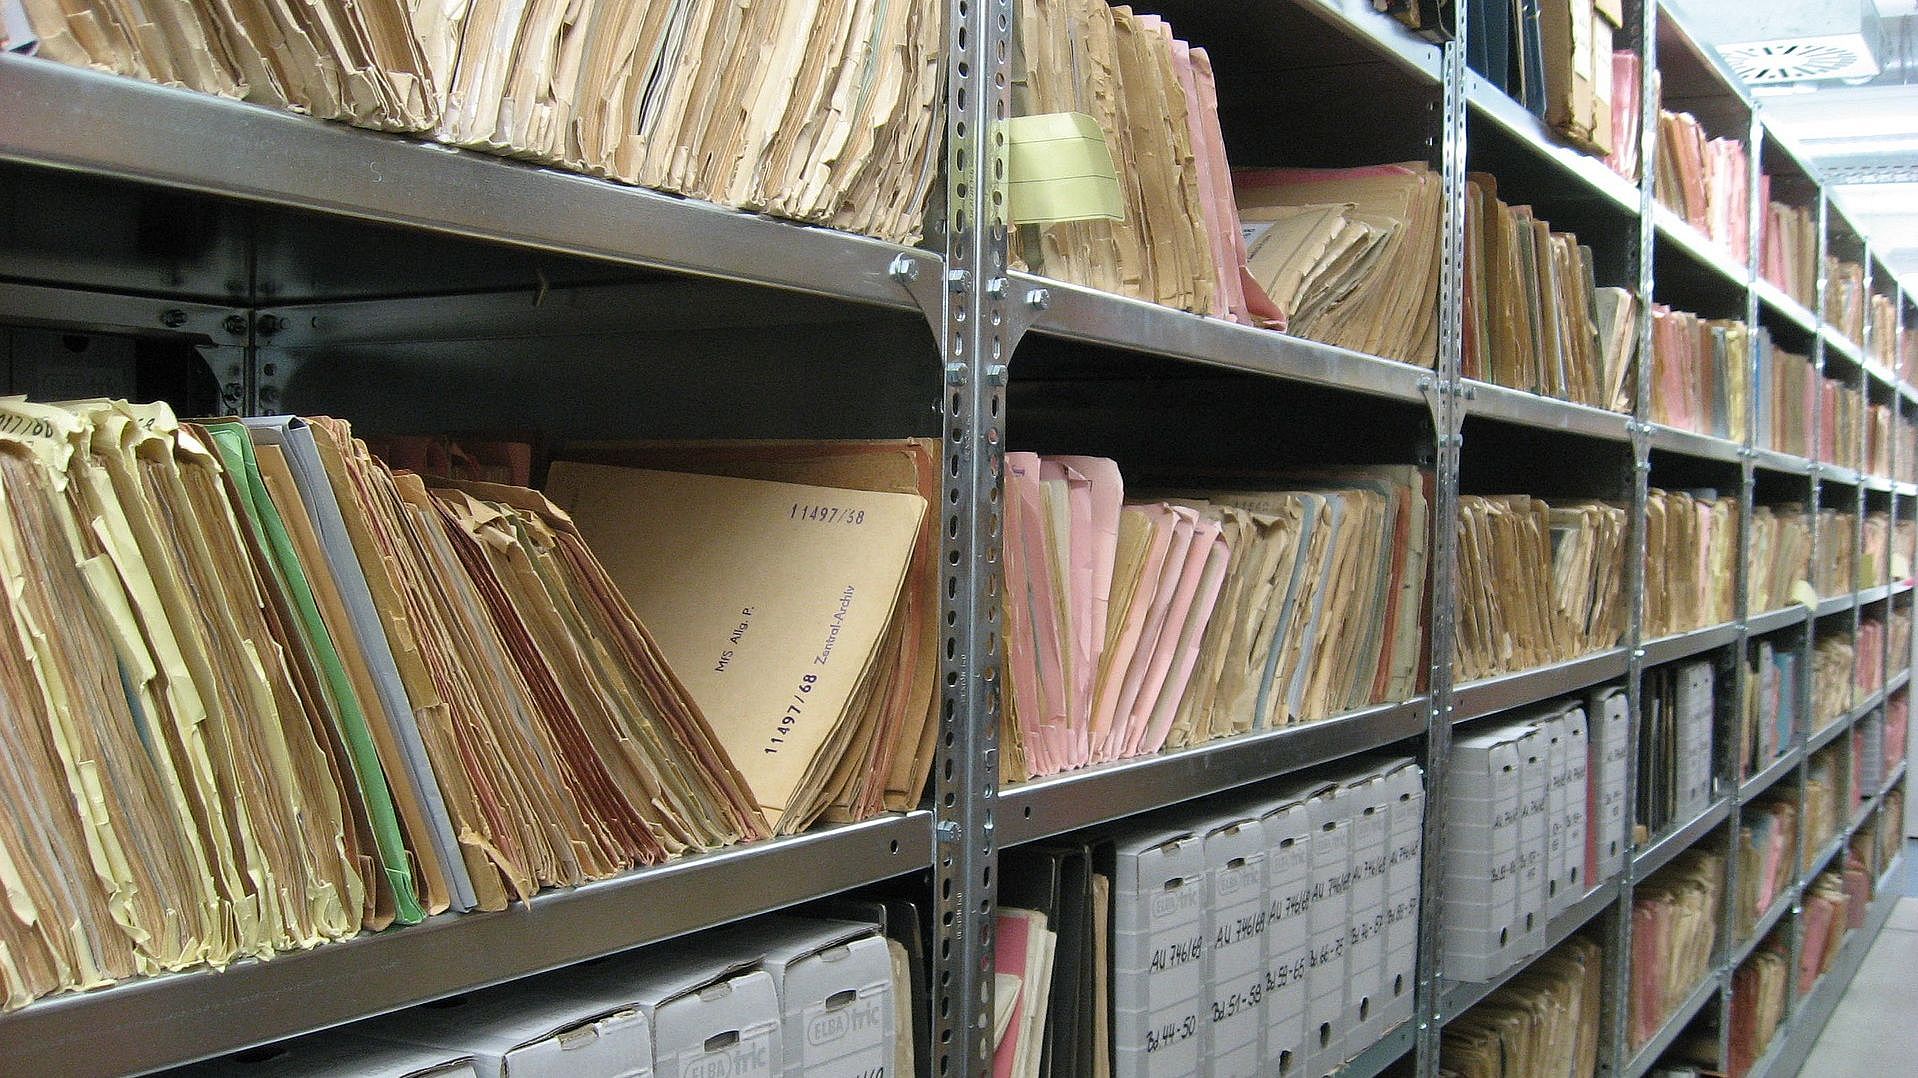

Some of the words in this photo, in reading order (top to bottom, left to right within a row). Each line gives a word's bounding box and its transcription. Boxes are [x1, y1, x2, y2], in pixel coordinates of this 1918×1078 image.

[764, 674, 818, 754] 11497/68
[814, 585, 855, 665] Zentral-Archiv
[1215, 925, 1232, 950] AU
[1150, 949, 1166, 973] AU
[815, 1015, 844, 1040] ELBA
